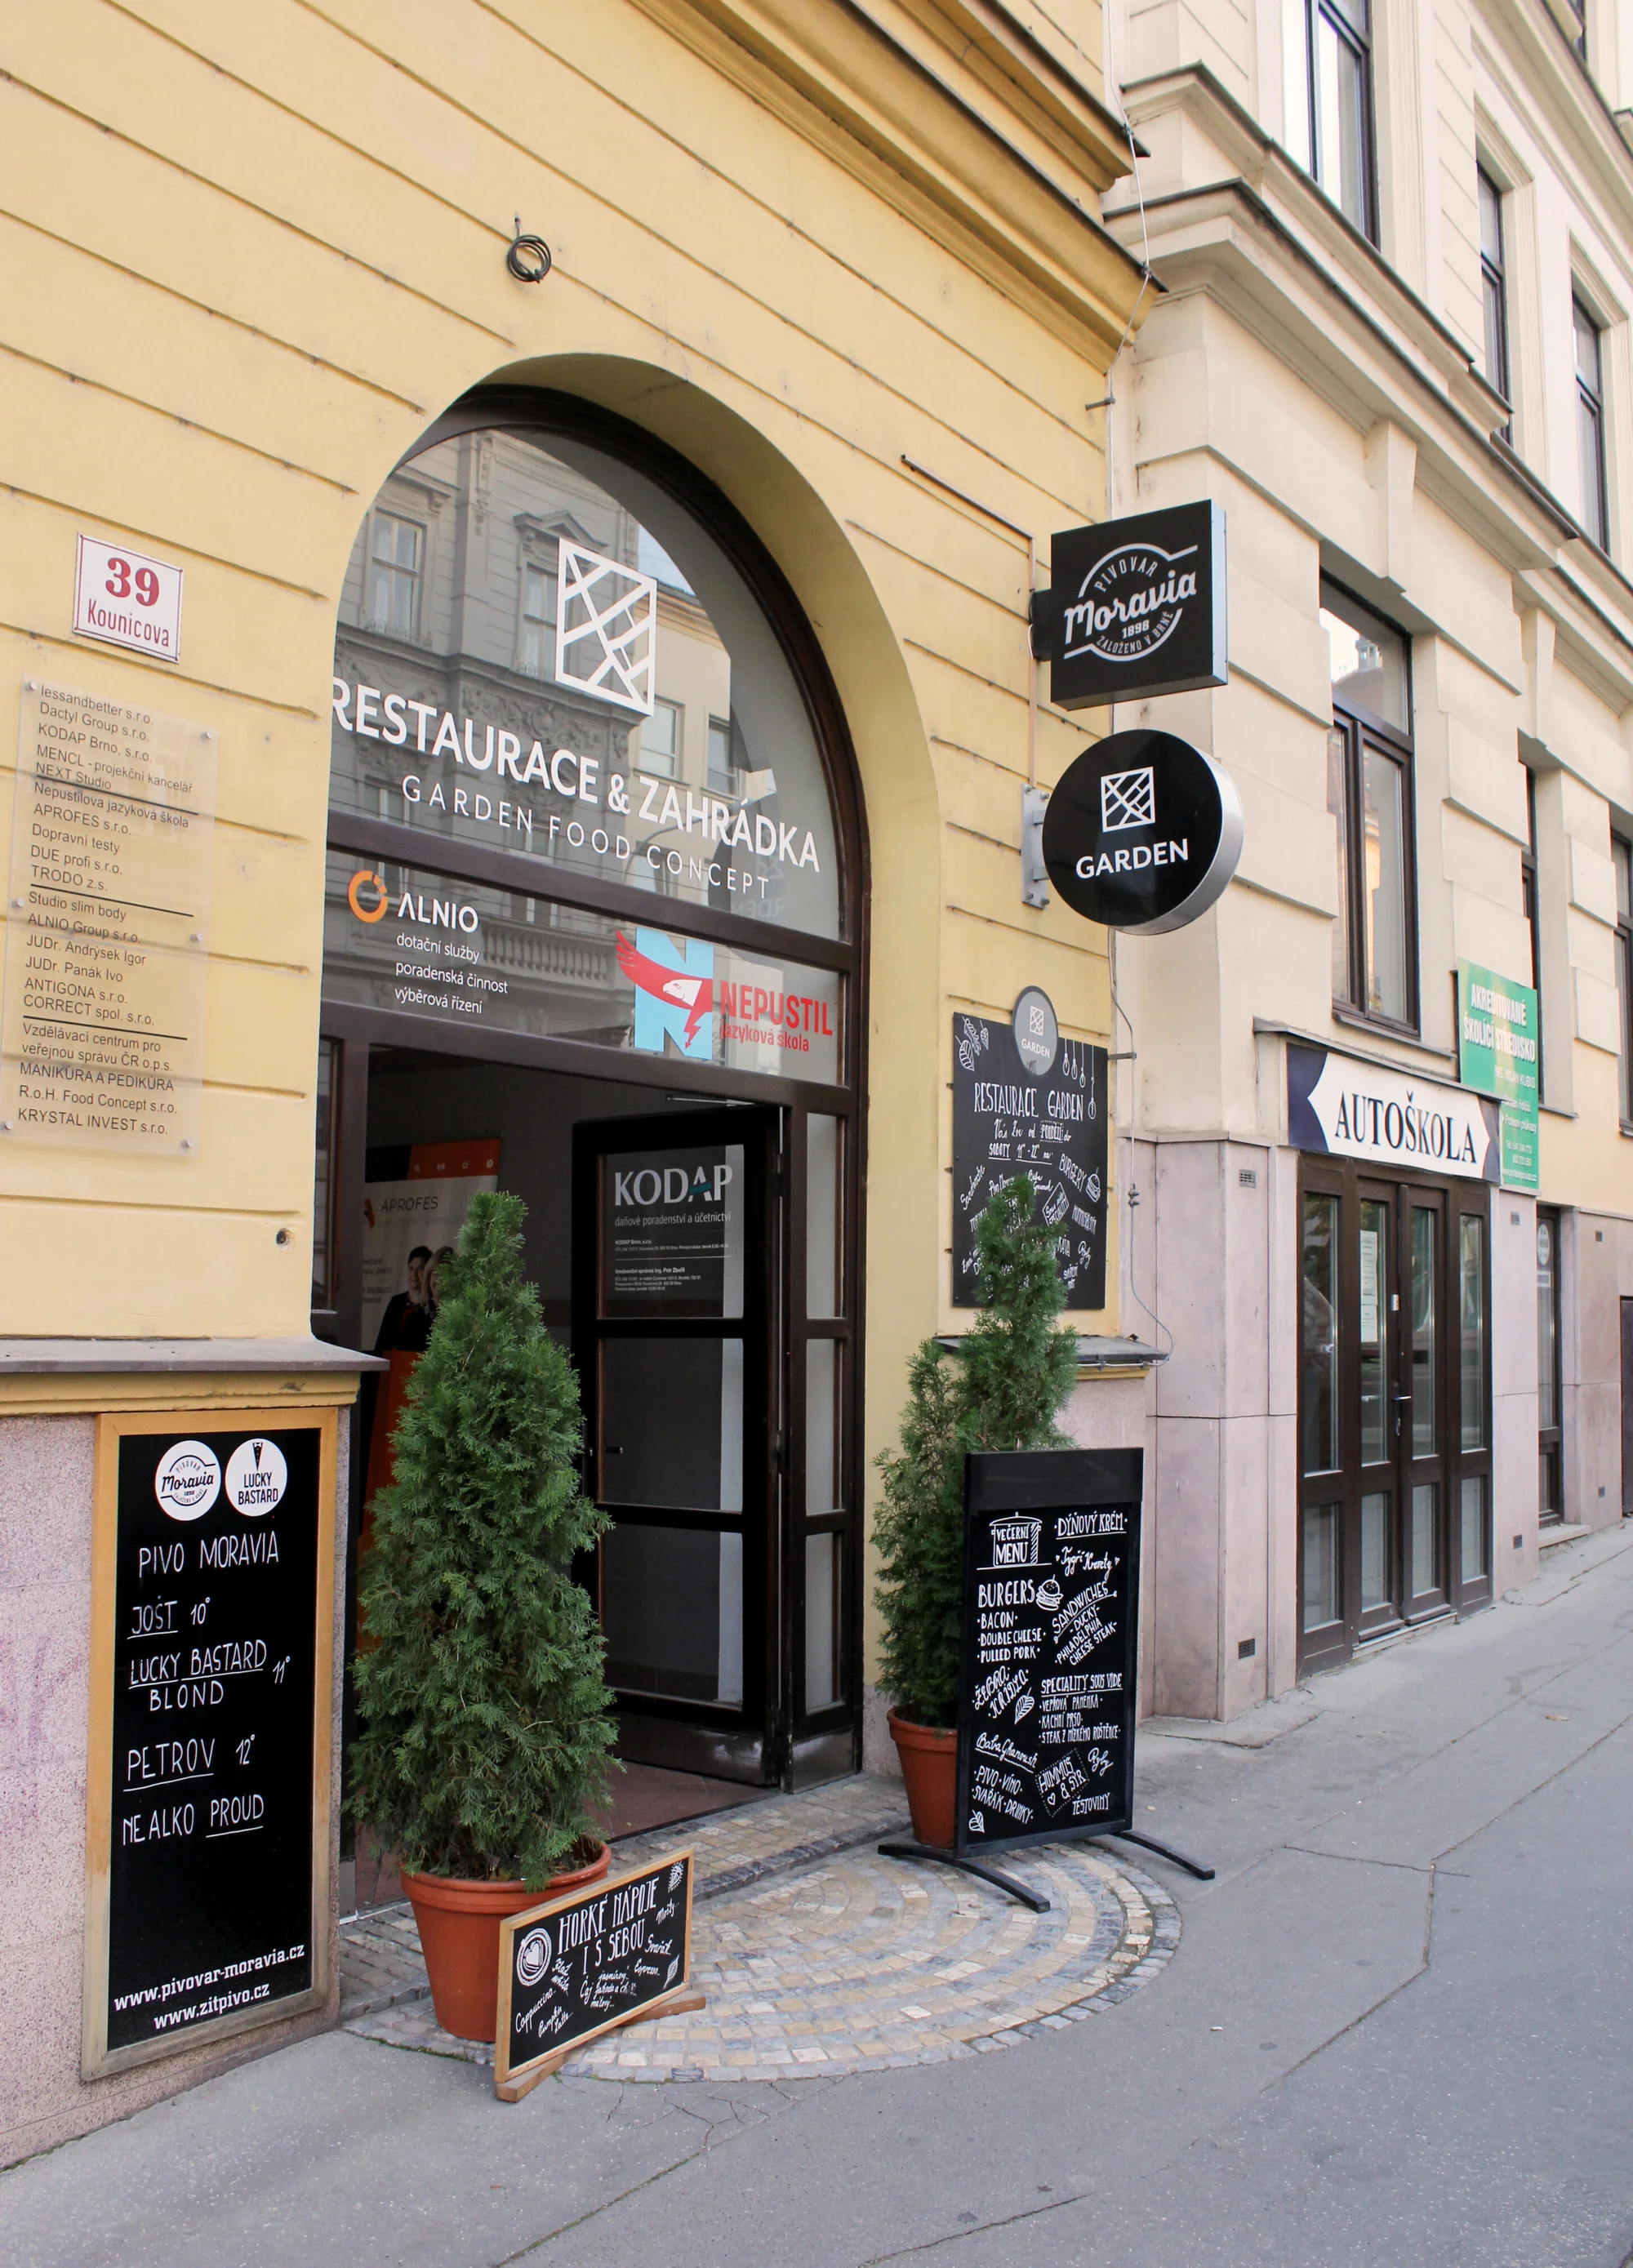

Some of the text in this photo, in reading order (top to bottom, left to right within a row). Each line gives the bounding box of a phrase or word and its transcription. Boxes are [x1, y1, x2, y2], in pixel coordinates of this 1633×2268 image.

[105, 557, 159, 607] 39
[1094, 556, 1158, 592] PIVOVAR
[1064, 570, 1196, 644] Moravia
[87, 598, 170, 648] Kounicova
[1097, 611, 1174, 653] ZALOŽENO V BRNĚ
[1123, 620, 1150, 638] 1898
[41, 684, 154, 725] lessandbetter s.r.o.
[40, 702, 149, 741] Dactyl Group s.r.o.
[38, 723, 152, 762] KODAP Brno, s.r.o.
[36, 762, 112, 790] NEXT Studio
[37, 745, 193, 793] MENCL projekční kancelář
[332, 676, 821, 873] RESTAURACE & ZAHRÁDKA
[33, 803, 131, 835] APROFES s.r.o.
[34, 781, 189, 828] Nepustilova jazyková škola
[32, 823, 120, 856] Dopravní testy
[402, 775, 770, 899] GARDEN FOOD CONCEPT
[31, 845, 122, 874] DUE profi s.r.o.
[1076, 838, 1189, 879] GARDEN
[32, 865, 108, 891] TRODO z.s.
[29, 892, 127, 923] Studio slim body
[398, 892, 478, 933] ALNIO
[28, 913, 141, 944] ALNIO Group s.r.o.
[26, 935, 146, 966] JUDr. Andrýsek Igor
[397, 932, 480, 965] dotační služby
[25, 956, 122, 982] JUDr. Panák Ivo
[395, 962, 508, 994] poradenská činnost
[24, 977, 127, 1003] ANTIGONA s.r.o.
[394, 986, 483, 1014] výběrová řízení
[24, 994, 154, 1025] CORRECT spol. s.r.o.
[720, 980, 833, 1036] NEPUSTIL
[1471, 984, 1527, 1028] AKREDITOVANÉ
[23, 1022, 161, 1053] Vzdělávací centrum pro
[720, 1022, 809, 1052] jazyková škola
[1021, 1038, 1050, 1058] GARDEN
[1496, 1026, 1535, 1064] STŘEDISKO
[22, 1043, 173, 1072] veřejnou správu ČR o.p.s.
[20, 1061, 174, 1092] MANIKÚRA A PEDIKÚRA
[20, 1085, 177, 1114] R.o.H. Food Concept s.r.o.
[974, 1083, 1083, 1121] RESTAURACE GARDEN
[18, 1108, 167, 1134] KRYSTAL INVEST s.r.o.
[1335, 1089, 1477, 1163] AUTOŠKOLA
[615, 1164, 732, 1207] KODAP
[1059, 1154, 1087, 1191] BURGERY
[380, 1196, 438, 1212] APROFES
[615, 1216, 640, 1226] daňové
[643, 1212, 686, 1226] poradenství
[694, 1211, 732, 1222] účetnictví
[162, 1471, 214, 1492] Moravia
[244, 1472, 272, 1488] LUCKY
[238, 1488, 278, 1505] BASTARD
[995, 1524, 1030, 1541] VEČERNÍ
[1058, 1511, 1124, 1537] DÝŇOVÝ KRÉM
[139, 1530, 278, 1578] PIVO MORAVIA
[995, 1541, 1029, 1565] MENU
[978, 1579, 1035, 1608] BURGERS
[1052, 1581, 1109, 1634] SANDWICHES
[131, 1595, 178, 1634] JOŠT
[981, 1611, 1014, 1629] BACON
[981, 1628, 1042, 1647] DOUBLE CHEESE
[1057, 1617, 1101, 1664] PHILADELPHIA
[131, 1639, 267, 1685] LUCKY BASTARD
[981, 1645, 1036, 1663] PULLED PORK
[1070, 1642, 1095, 1665] CHEESE
[149, 1680, 224, 1711] BLOND
[1041, 1674, 1104, 1693] SPECIALITY SOUS
[1042, 1694, 1098, 1711] VEPŘOVÁ PANENKA
[1041, 1711, 1081, 1728] KACHNÍ PRSO
[976, 1732, 1038, 1768] Baba Ghanoush
[1041, 1729, 1061, 1744] STEAK
[128, 1738, 215, 1781] PETROV
[1038, 1757, 1075, 1793] HUMMUS
[1088, 1747, 1114, 1776] Ryby
[977, 1765, 1021, 1795] PIVO VÍNO
[1061, 1782, 1070, 1799] &
[210, 1794, 264, 1828] PROUD
[973, 1786, 1033, 1825] SVAŘÁK DRINKY
[1072, 1793, 1110, 1816] TĚSTOVINY
[558, 1877, 659, 1955] HORKÉ NÁPOJE
[583, 1919, 645, 1975] I S SEBOU
[114, 1944, 305, 2012] www.pivovar-moravia.cz
[580, 1976, 594, 2005] Čaj
[154, 1983, 269, 2030] www.zitpivo.cz
